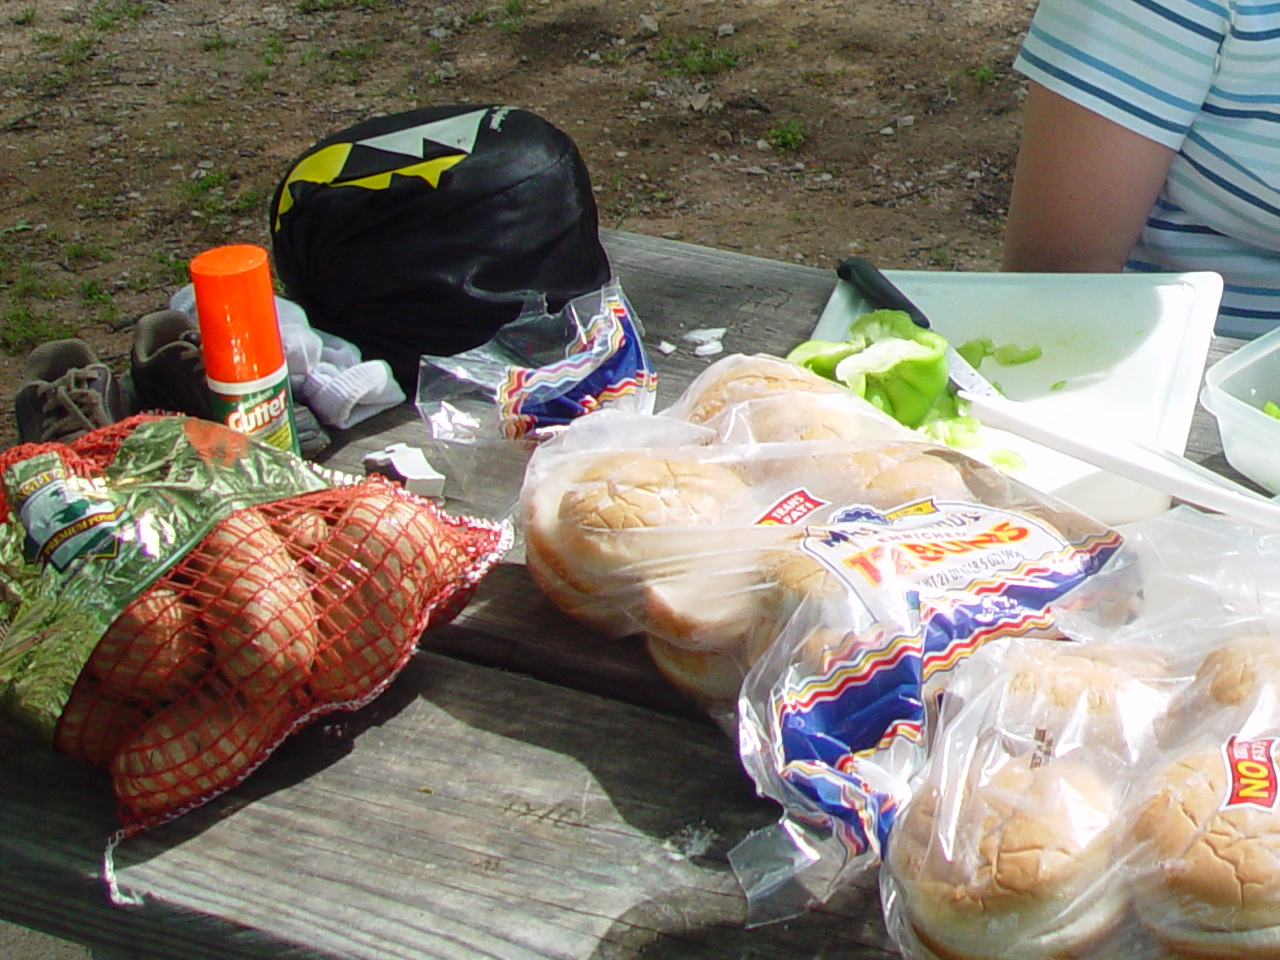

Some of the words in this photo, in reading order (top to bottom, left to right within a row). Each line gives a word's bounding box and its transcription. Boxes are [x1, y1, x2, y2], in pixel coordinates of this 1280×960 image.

[228, 389, 287, 433] Cutter
[771, 494, 805, 520] TRANS
[901, 521, 1029, 562] BUNS
[1237, 761, 1269, 798] NO
